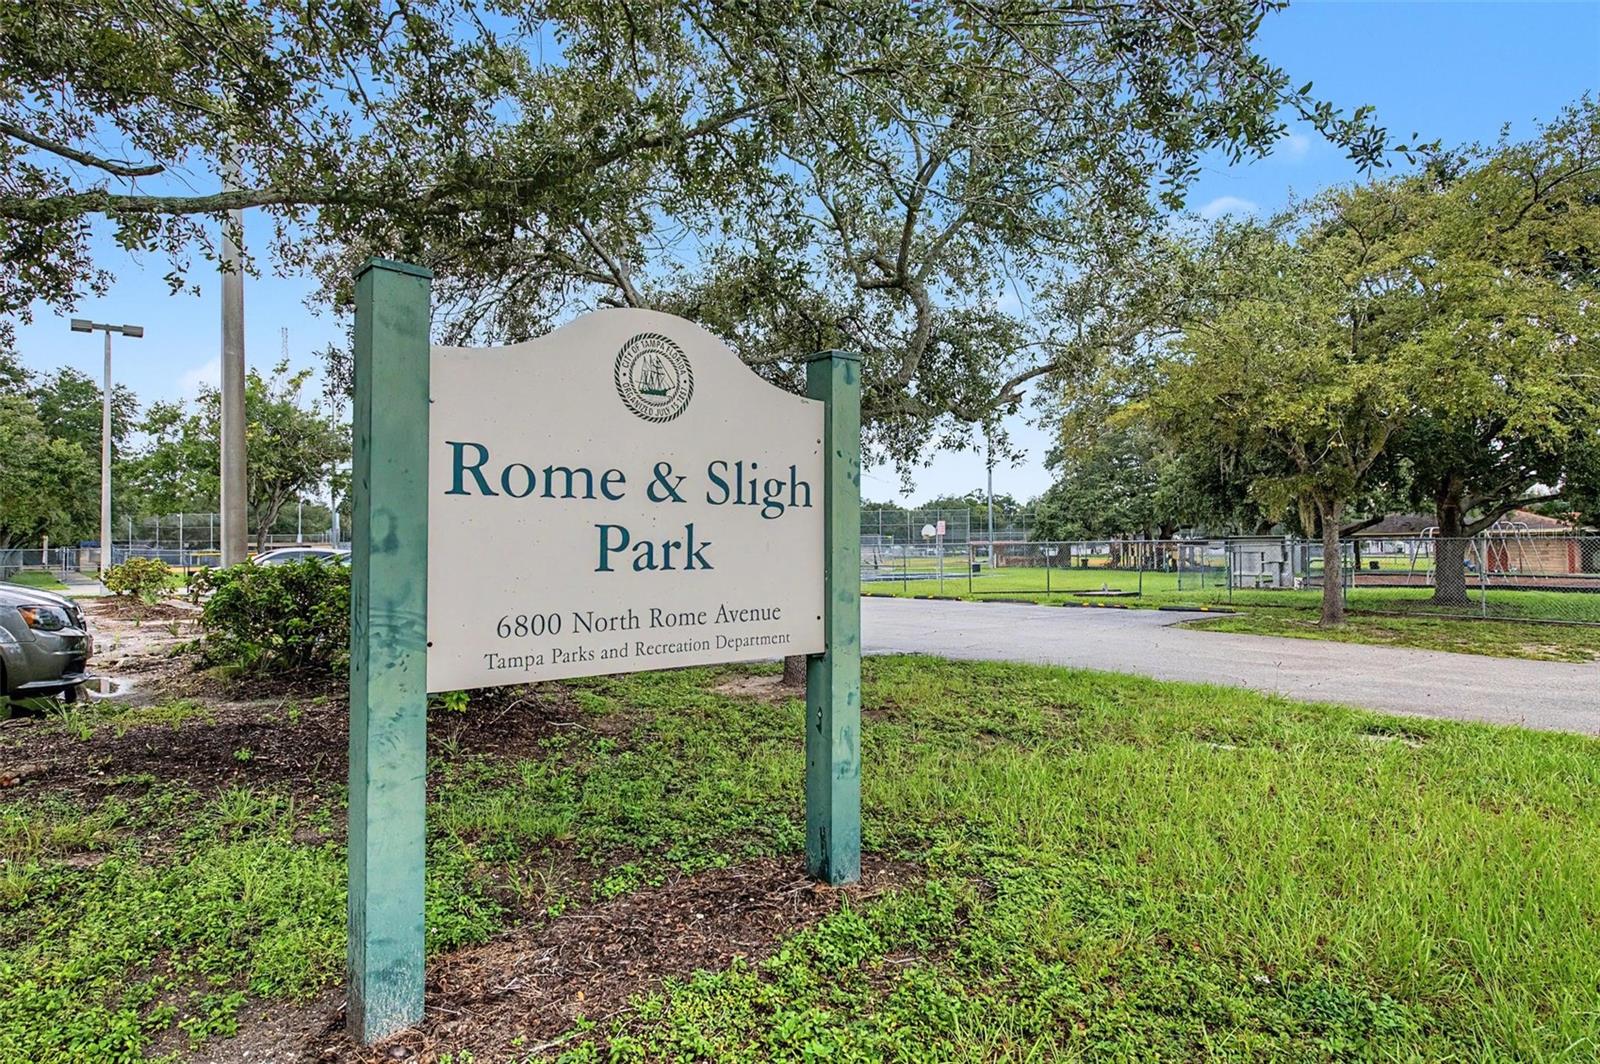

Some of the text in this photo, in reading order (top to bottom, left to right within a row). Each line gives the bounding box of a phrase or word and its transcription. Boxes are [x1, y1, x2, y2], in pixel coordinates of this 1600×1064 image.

[622, 340, 687, 376] CITY OF TAMPA FLORIDA
[622, 382, 654, 416] ORGANIZED
[655, 408, 671, 417] JULY
[444, 440, 813, 519] Rome & Sligh
[593, 523, 715, 572] Park
[496, 603, 782, 639] 6800 North Rome Avenue
[483, 631, 791, 672] Tampa Parks and Recreation Department
